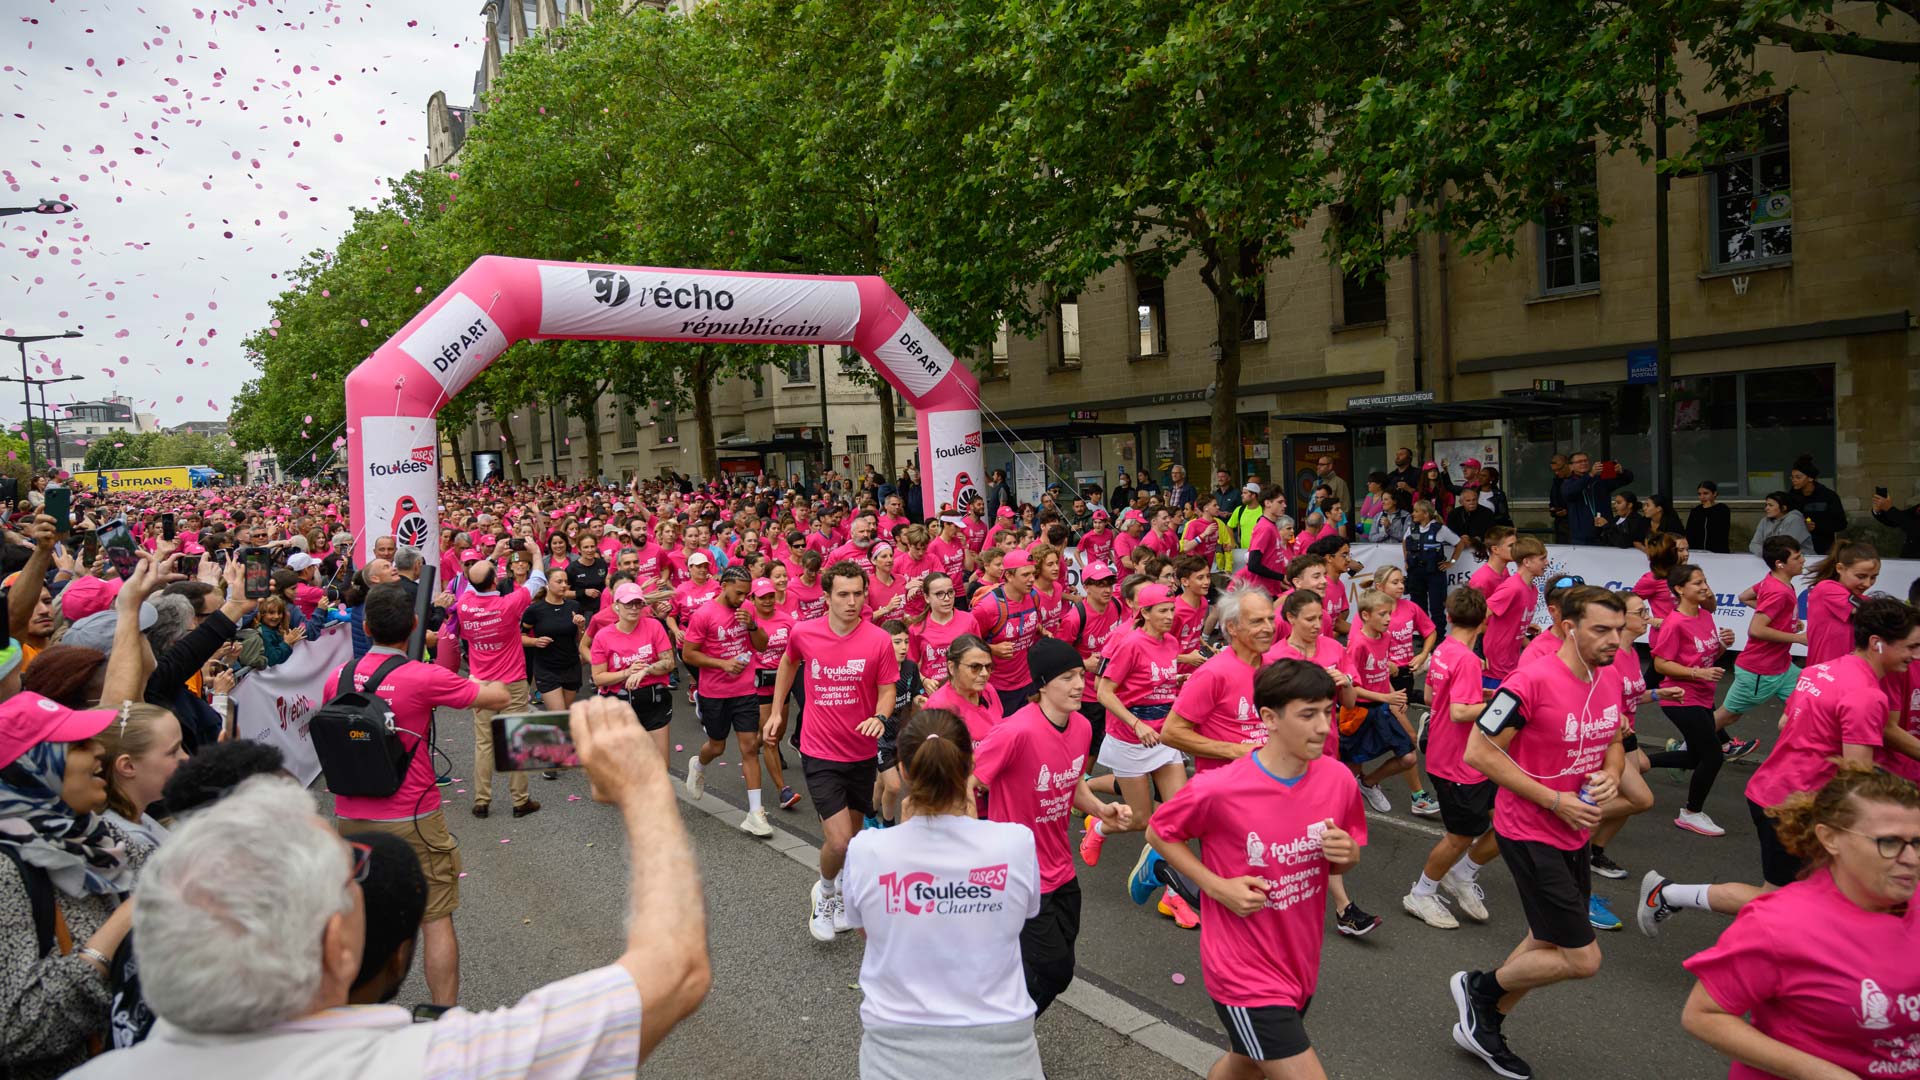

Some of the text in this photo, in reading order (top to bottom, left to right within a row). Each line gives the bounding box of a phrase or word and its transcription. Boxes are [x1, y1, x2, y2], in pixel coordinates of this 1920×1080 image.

[680, 316, 822, 338] républicain
[432, 318, 488, 373] DÉPART
[899, 332, 942, 378] DÉPART
[411, 448, 434, 463] roses
[935, 444, 977, 459] foulées
[369, 459, 428, 477] foulées
[111, 476, 173, 488] SITRANS
[969, 867, 1007, 886] roses
[914, 881, 993, 901] foulées
[936, 898, 1004, 915] Chartres
